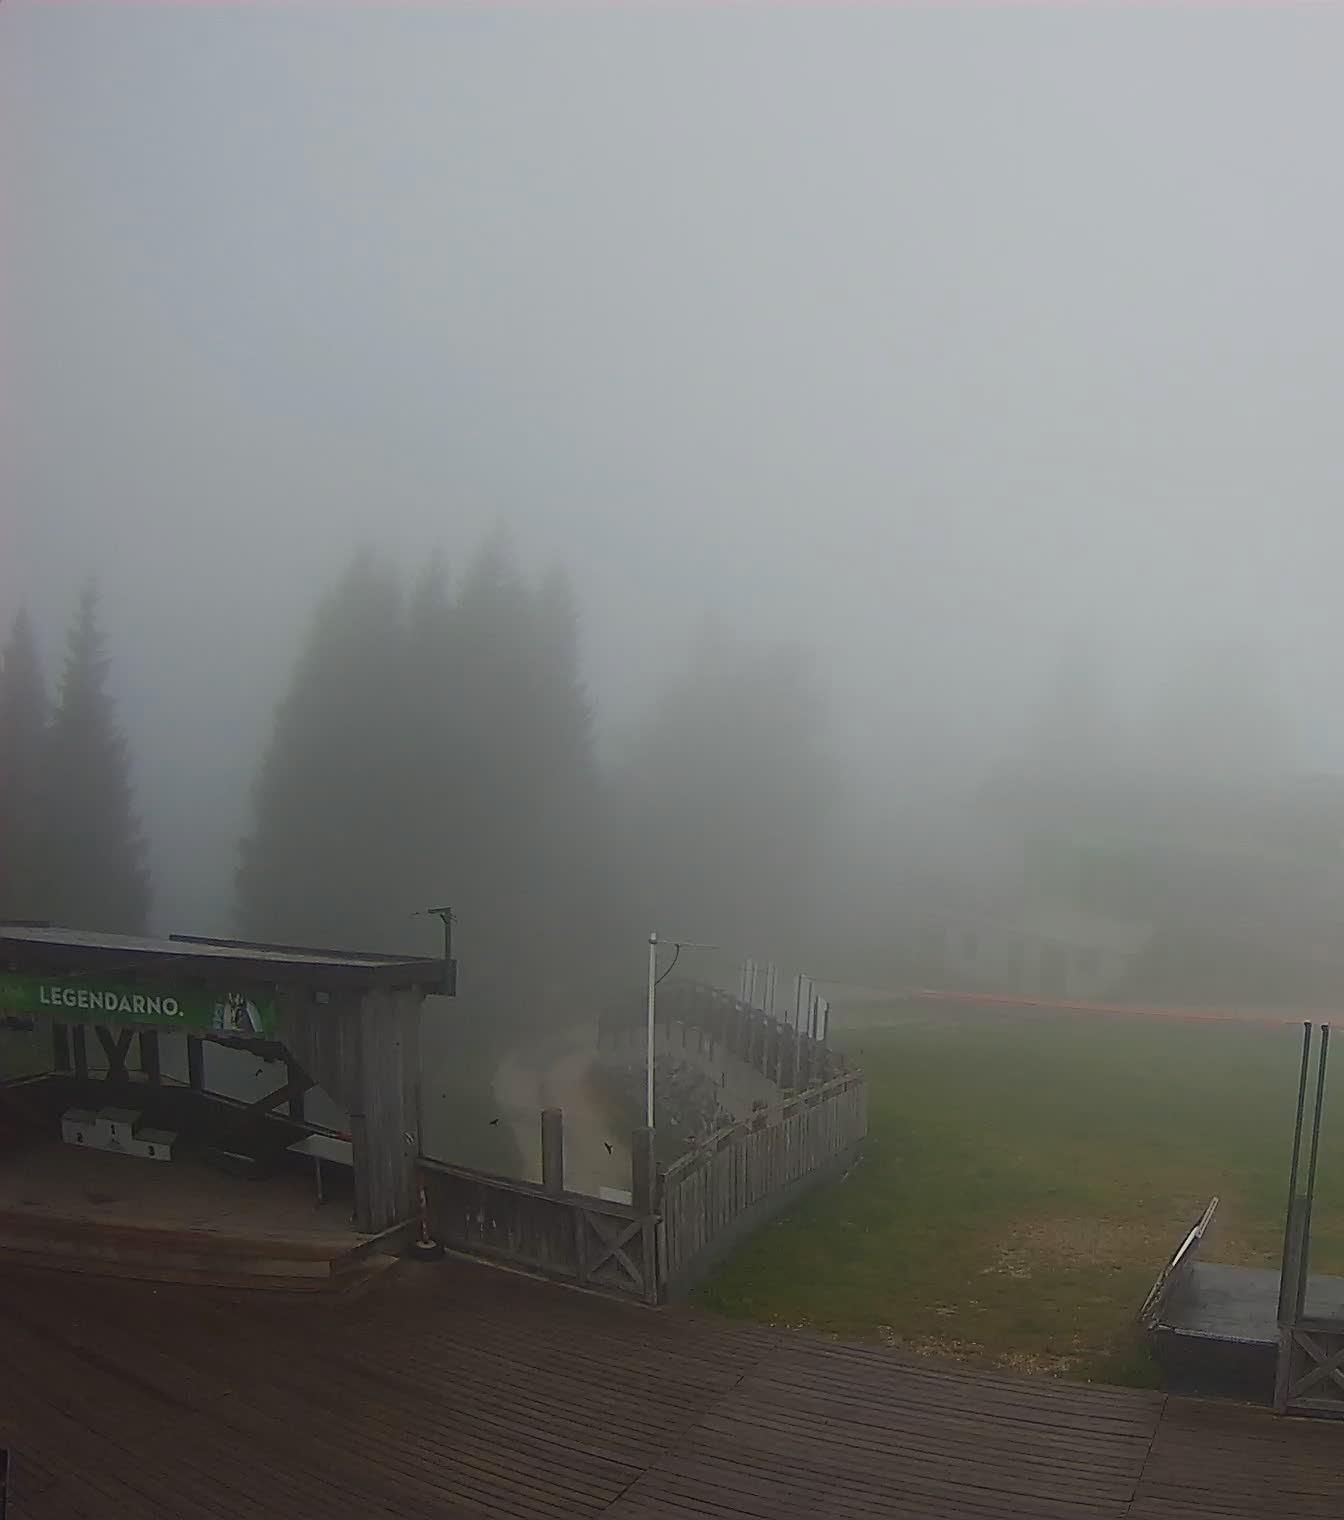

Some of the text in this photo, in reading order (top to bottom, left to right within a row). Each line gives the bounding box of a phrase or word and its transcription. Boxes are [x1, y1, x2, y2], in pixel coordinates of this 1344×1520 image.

[40, 986, 184, 1016] LEGENDARNO.
[76, 1132, 84, 1144] 2
[147, 1145, 156, 1156] 3
